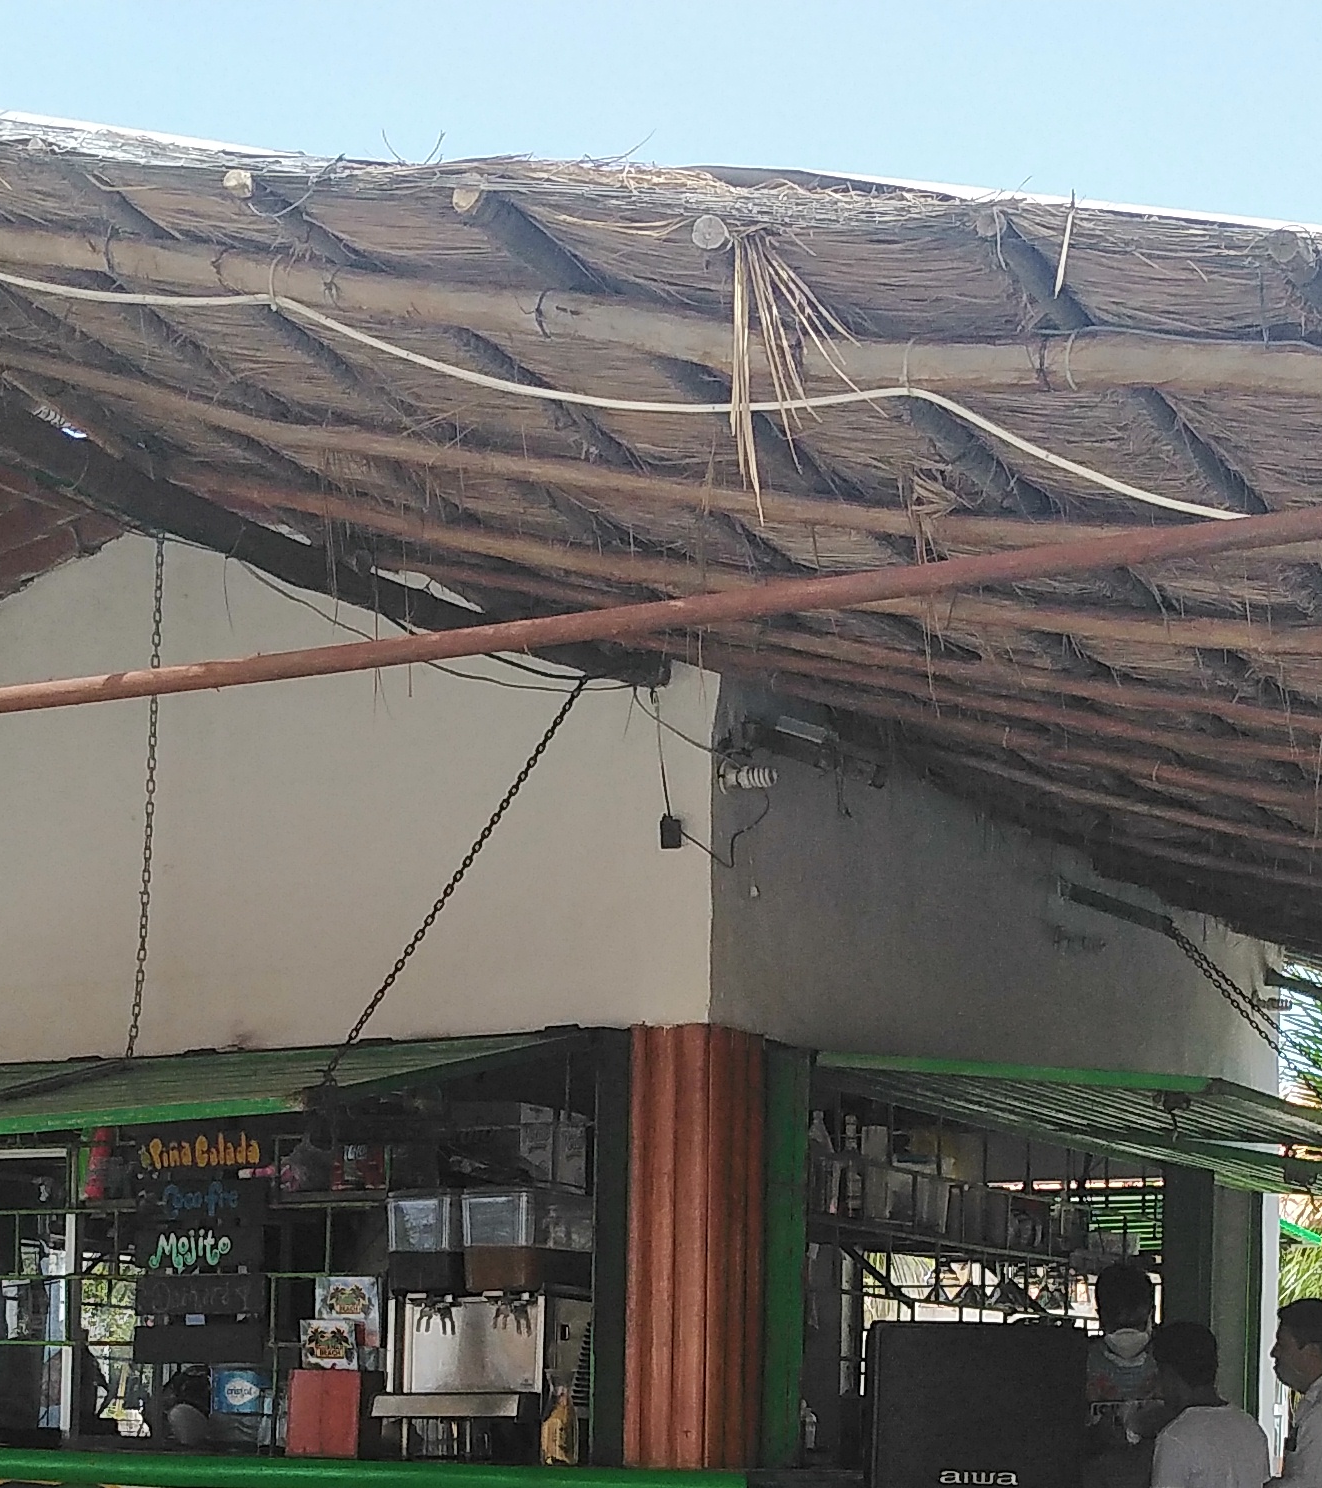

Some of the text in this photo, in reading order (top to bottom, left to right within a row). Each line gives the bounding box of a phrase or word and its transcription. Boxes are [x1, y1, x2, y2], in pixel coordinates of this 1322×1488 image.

[195, 1131, 260, 1167] Colada
[148, 1228, 232, 1269] Mojito
[939, 1470, 1018, 1486] aiwa
